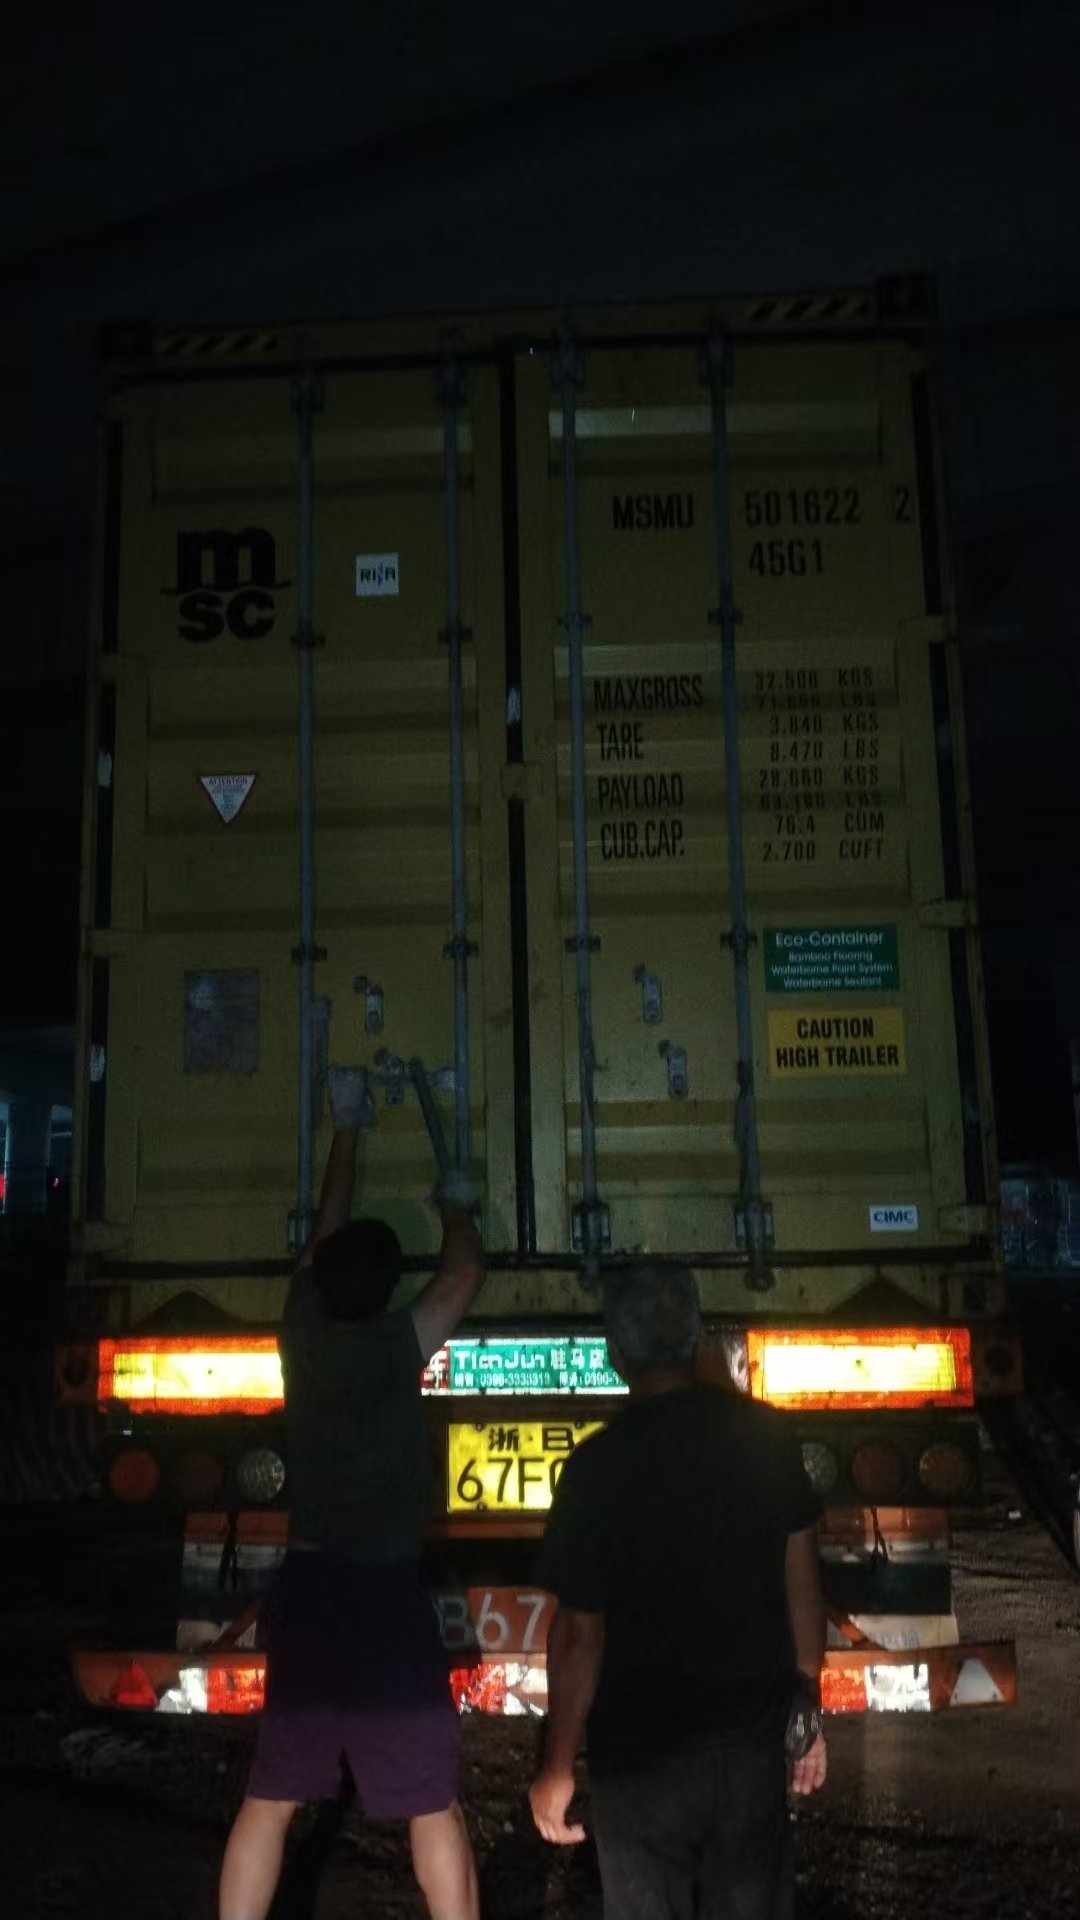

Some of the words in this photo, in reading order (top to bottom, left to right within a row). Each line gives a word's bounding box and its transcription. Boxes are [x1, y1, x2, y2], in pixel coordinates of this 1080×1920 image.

[612, 494, 695, 530] MSMU
[745, 488, 861, 526] 501622
[894, 486, 914, 523] 2
[748, 540, 824, 577] 45G1
[594, 675, 703, 711] MAXGROSS
[838, 667, 873, 688] KGS
[841, 692, 876, 707] LBS
[597, 722, 644, 761] TARE
[770, 714, 822, 734] 3.840
[843, 712, 878, 731] KGS
[771, 740, 823, 761] 8.470
[844, 739, 878, 758] LBS
[598, 773, 684, 810] PAYLOAD
[844, 766, 879, 785] KGS
[846, 791, 882, 808] LBS
[601, 820, 686, 860] CUB.CAP.
[776, 814, 816, 834] 76.4
[845, 812, 884, 832] CUM
[763, 840, 816, 862] 2.700
[839, 839, 882, 859] CUFT
[775, 931, 884, 947] Eco-Container
[788, 952, 831, 963] Bamboo
[797, 1017, 874, 1039] CAUTION
[776, 1046, 819, 1068] HIGH
[825, 1045, 899, 1067] TRAILER
[873, 1210, 915, 1225] CIMC
